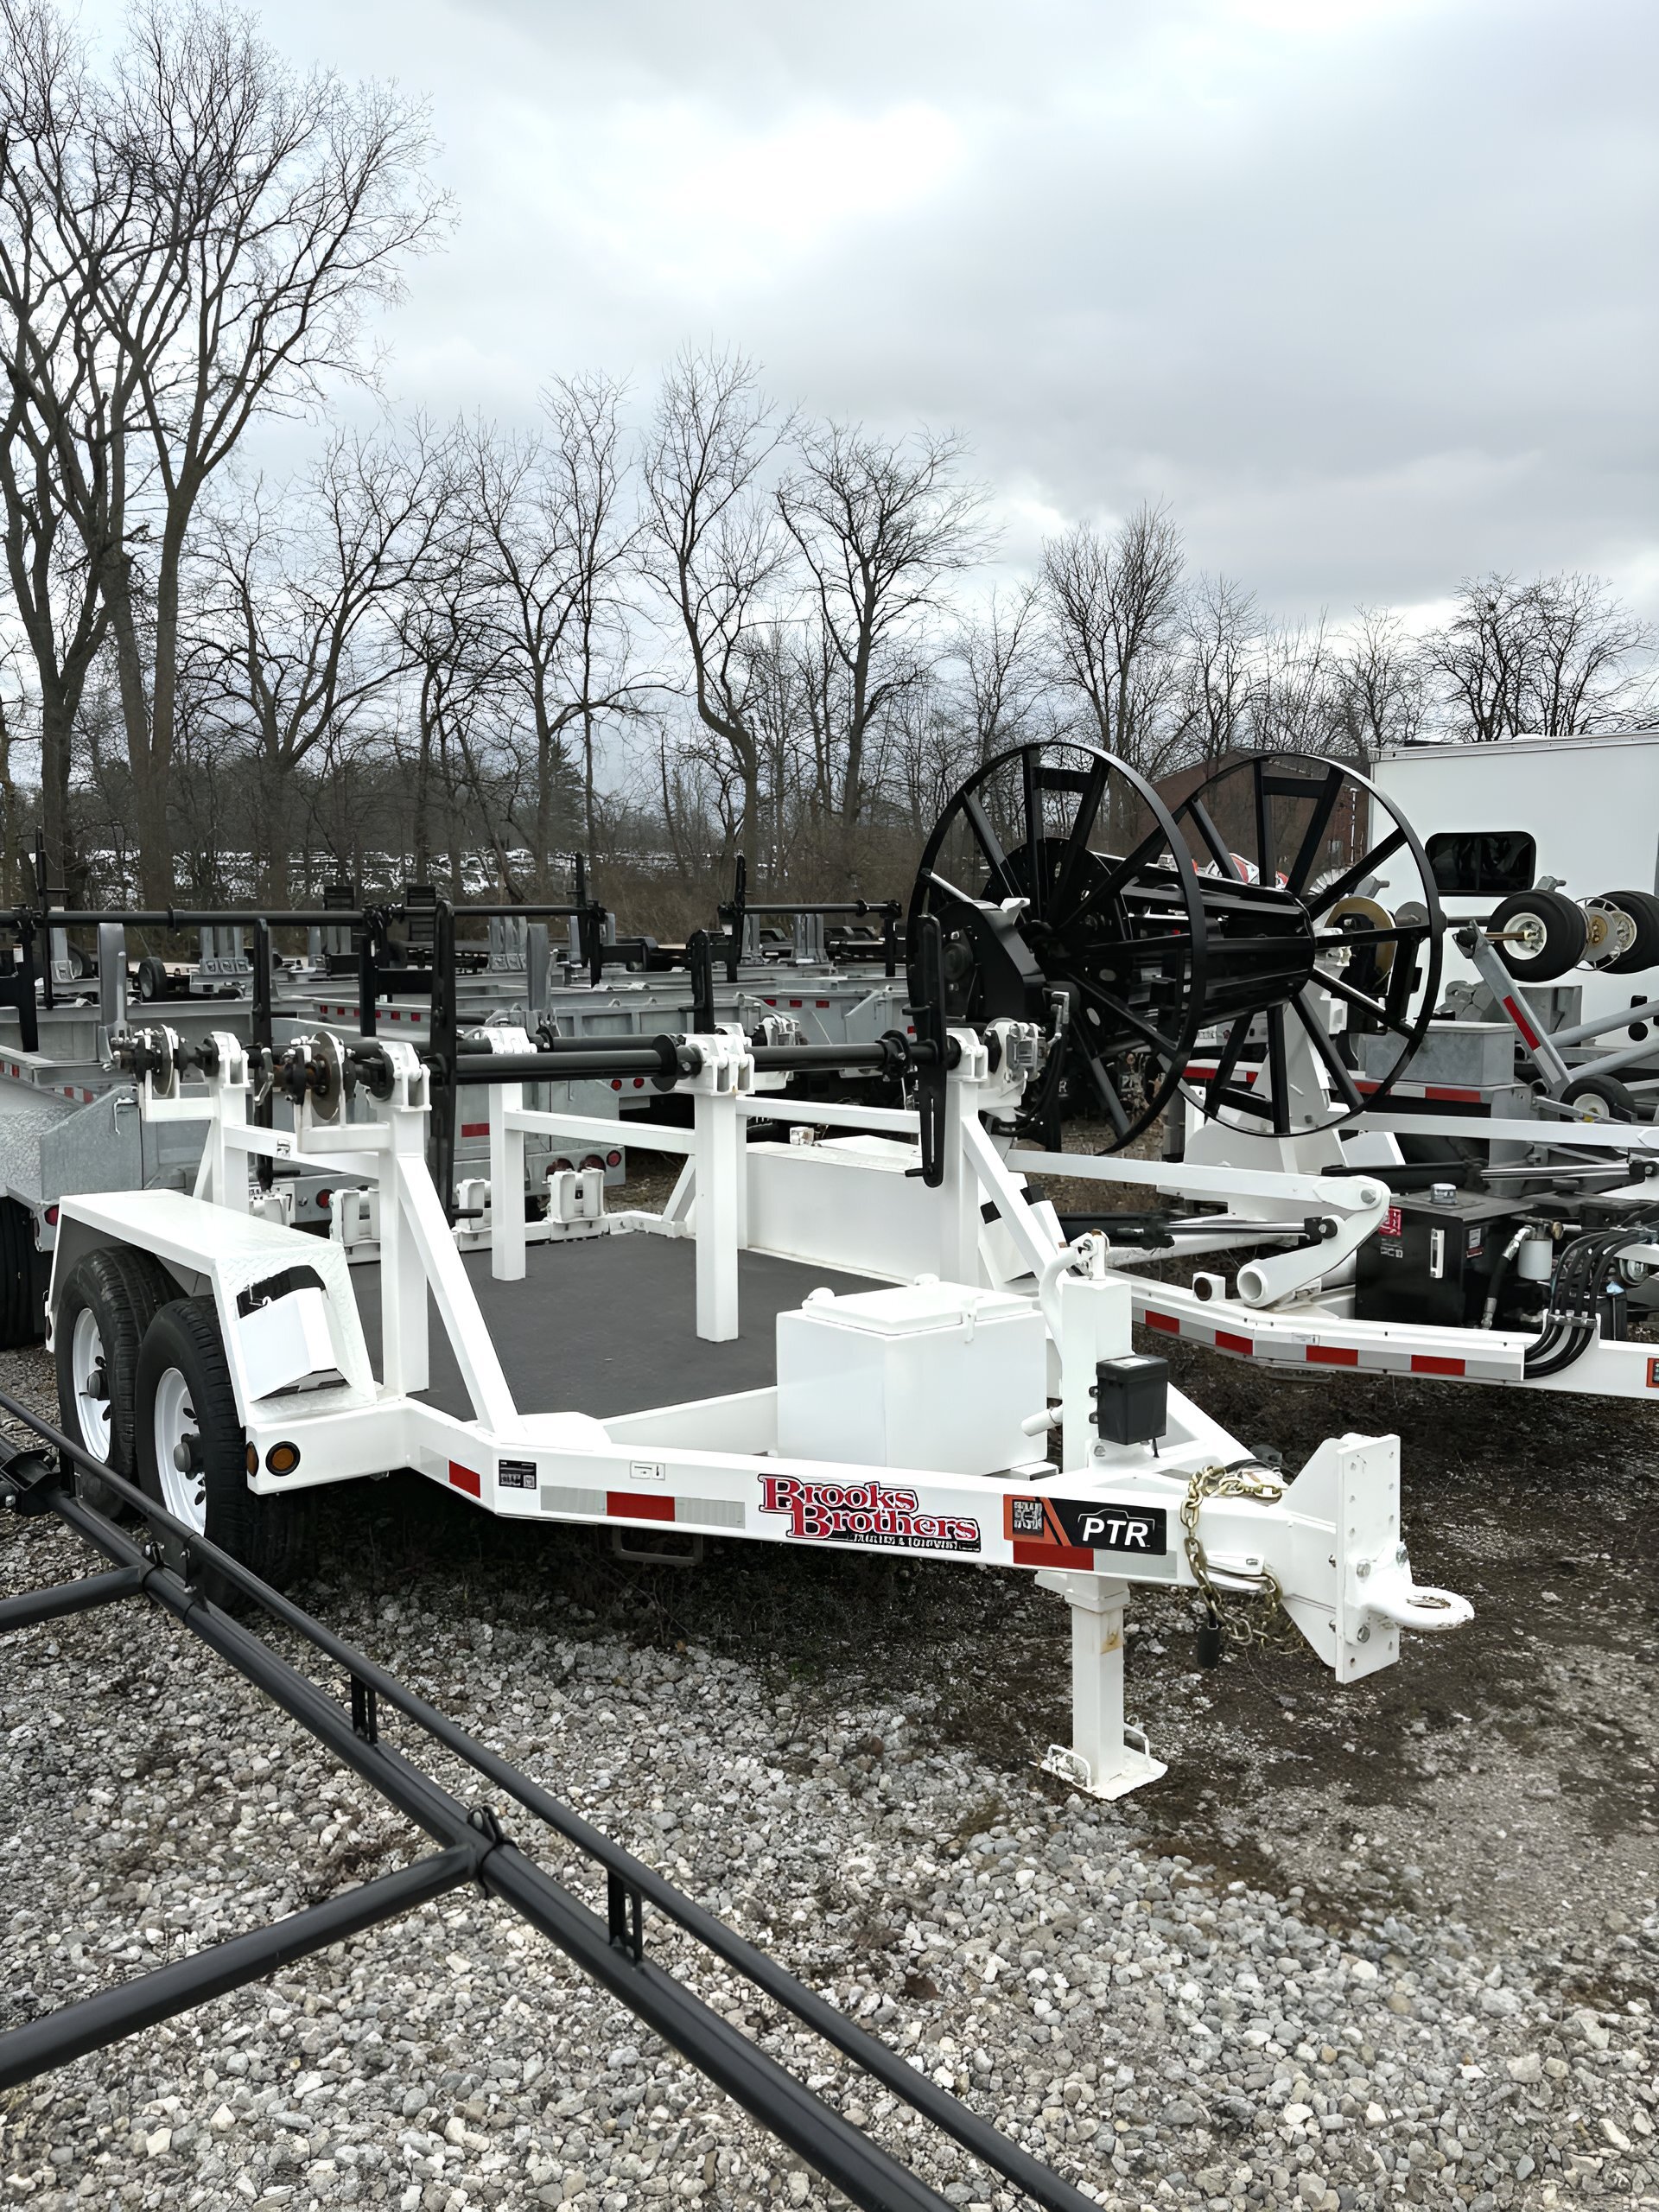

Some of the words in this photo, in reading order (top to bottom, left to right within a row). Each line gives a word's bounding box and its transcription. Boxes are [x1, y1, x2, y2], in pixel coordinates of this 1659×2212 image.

[759, 1474, 917, 1513] Brooks
[787, 1502, 980, 1541] Brothers
[1082, 1516, 1148, 1548] PTR
